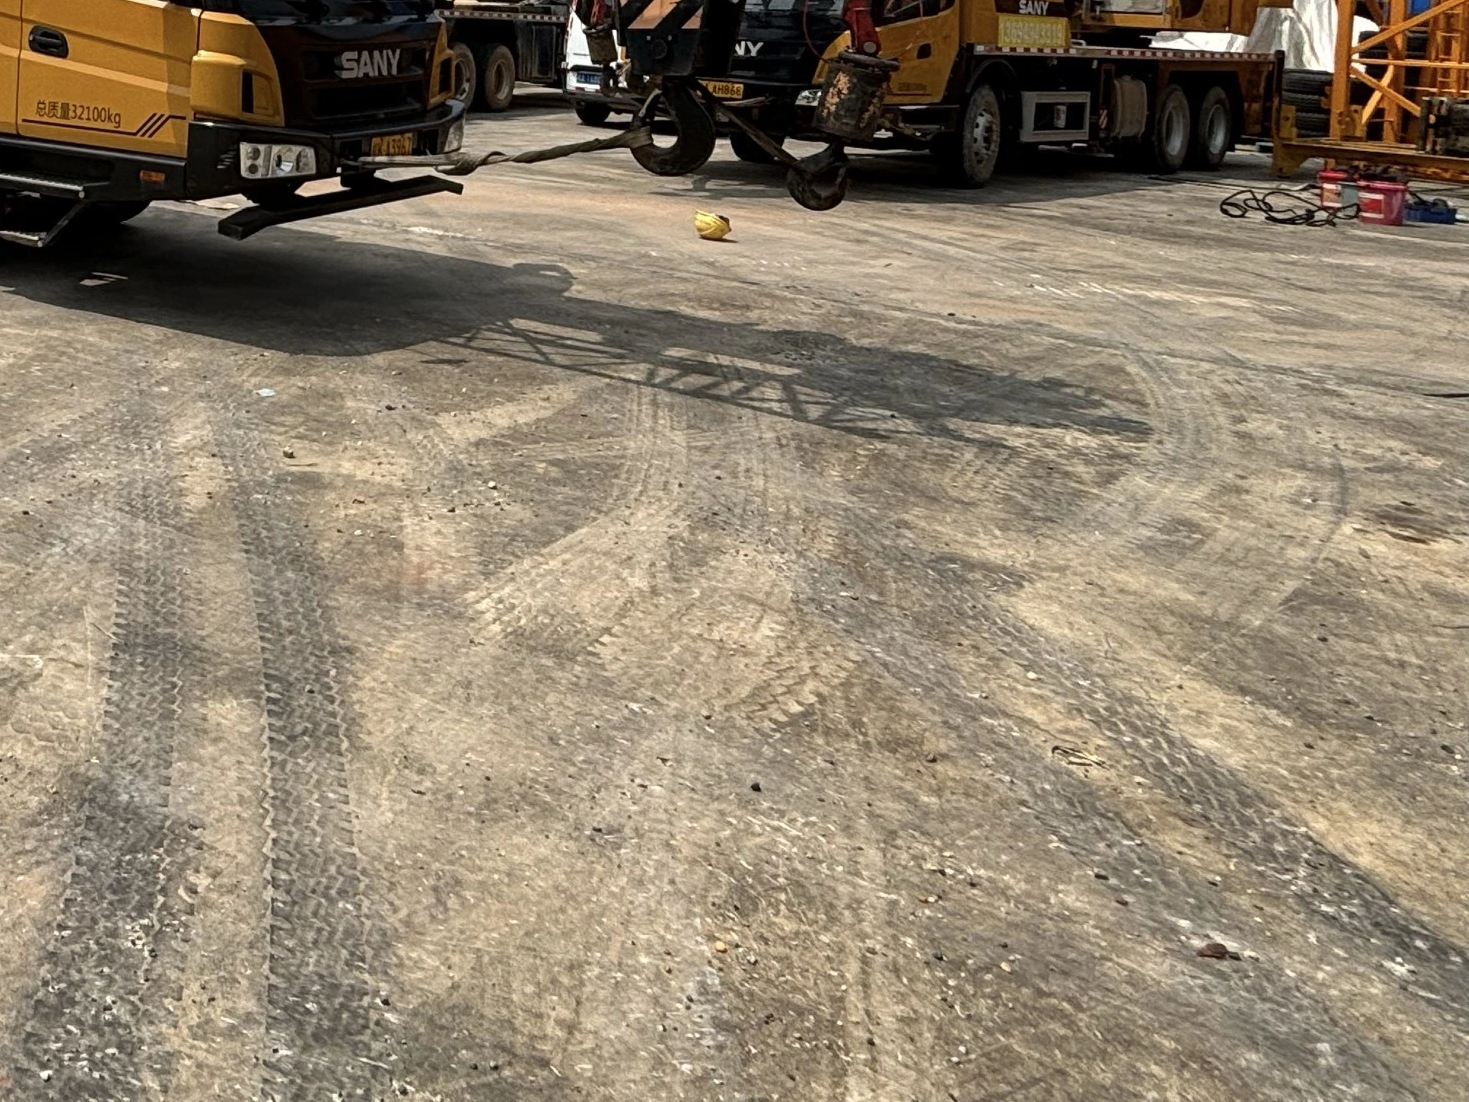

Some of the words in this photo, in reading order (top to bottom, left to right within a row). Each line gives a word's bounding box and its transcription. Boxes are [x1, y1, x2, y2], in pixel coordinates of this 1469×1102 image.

[1018, 0, 1049, 16] SANY
[734, 41, 764, 56] NY
[338, 48, 401, 79] SANY
[35, 99, 121, 128] 总质量32100kg
